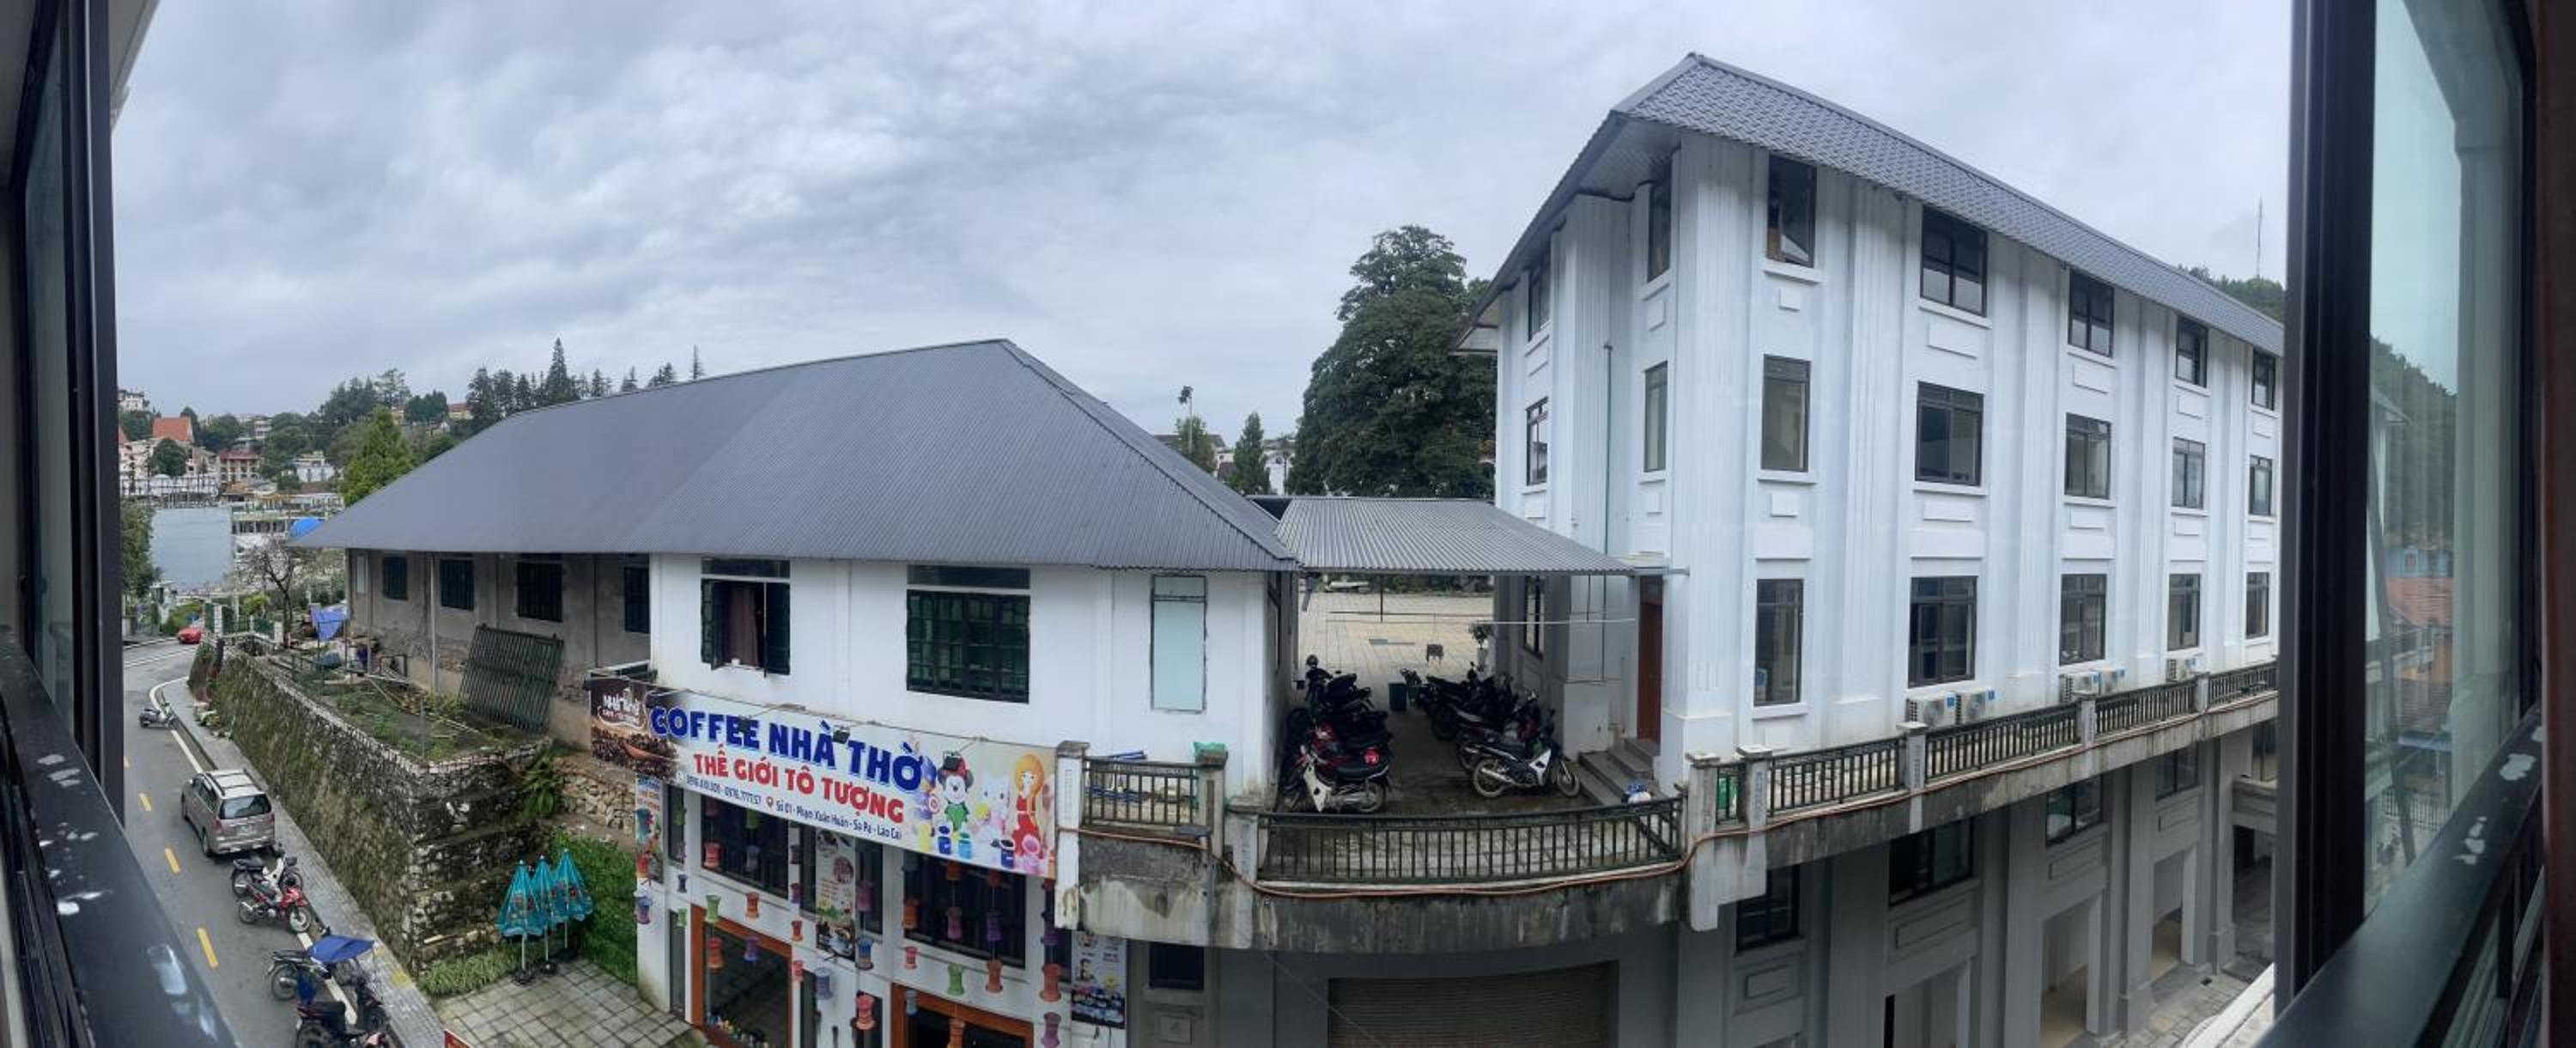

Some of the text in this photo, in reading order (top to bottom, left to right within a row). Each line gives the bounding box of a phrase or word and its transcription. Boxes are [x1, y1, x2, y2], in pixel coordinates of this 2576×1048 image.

[650, 707, 923, 791] COFFEE NHÀ THỜ
[694, 743, 728, 777] THẾ
[734, 756, 779, 787] GIỚI
[785, 765, 814, 794] TÔ
[821, 777, 904, 823] TƯỢNG
